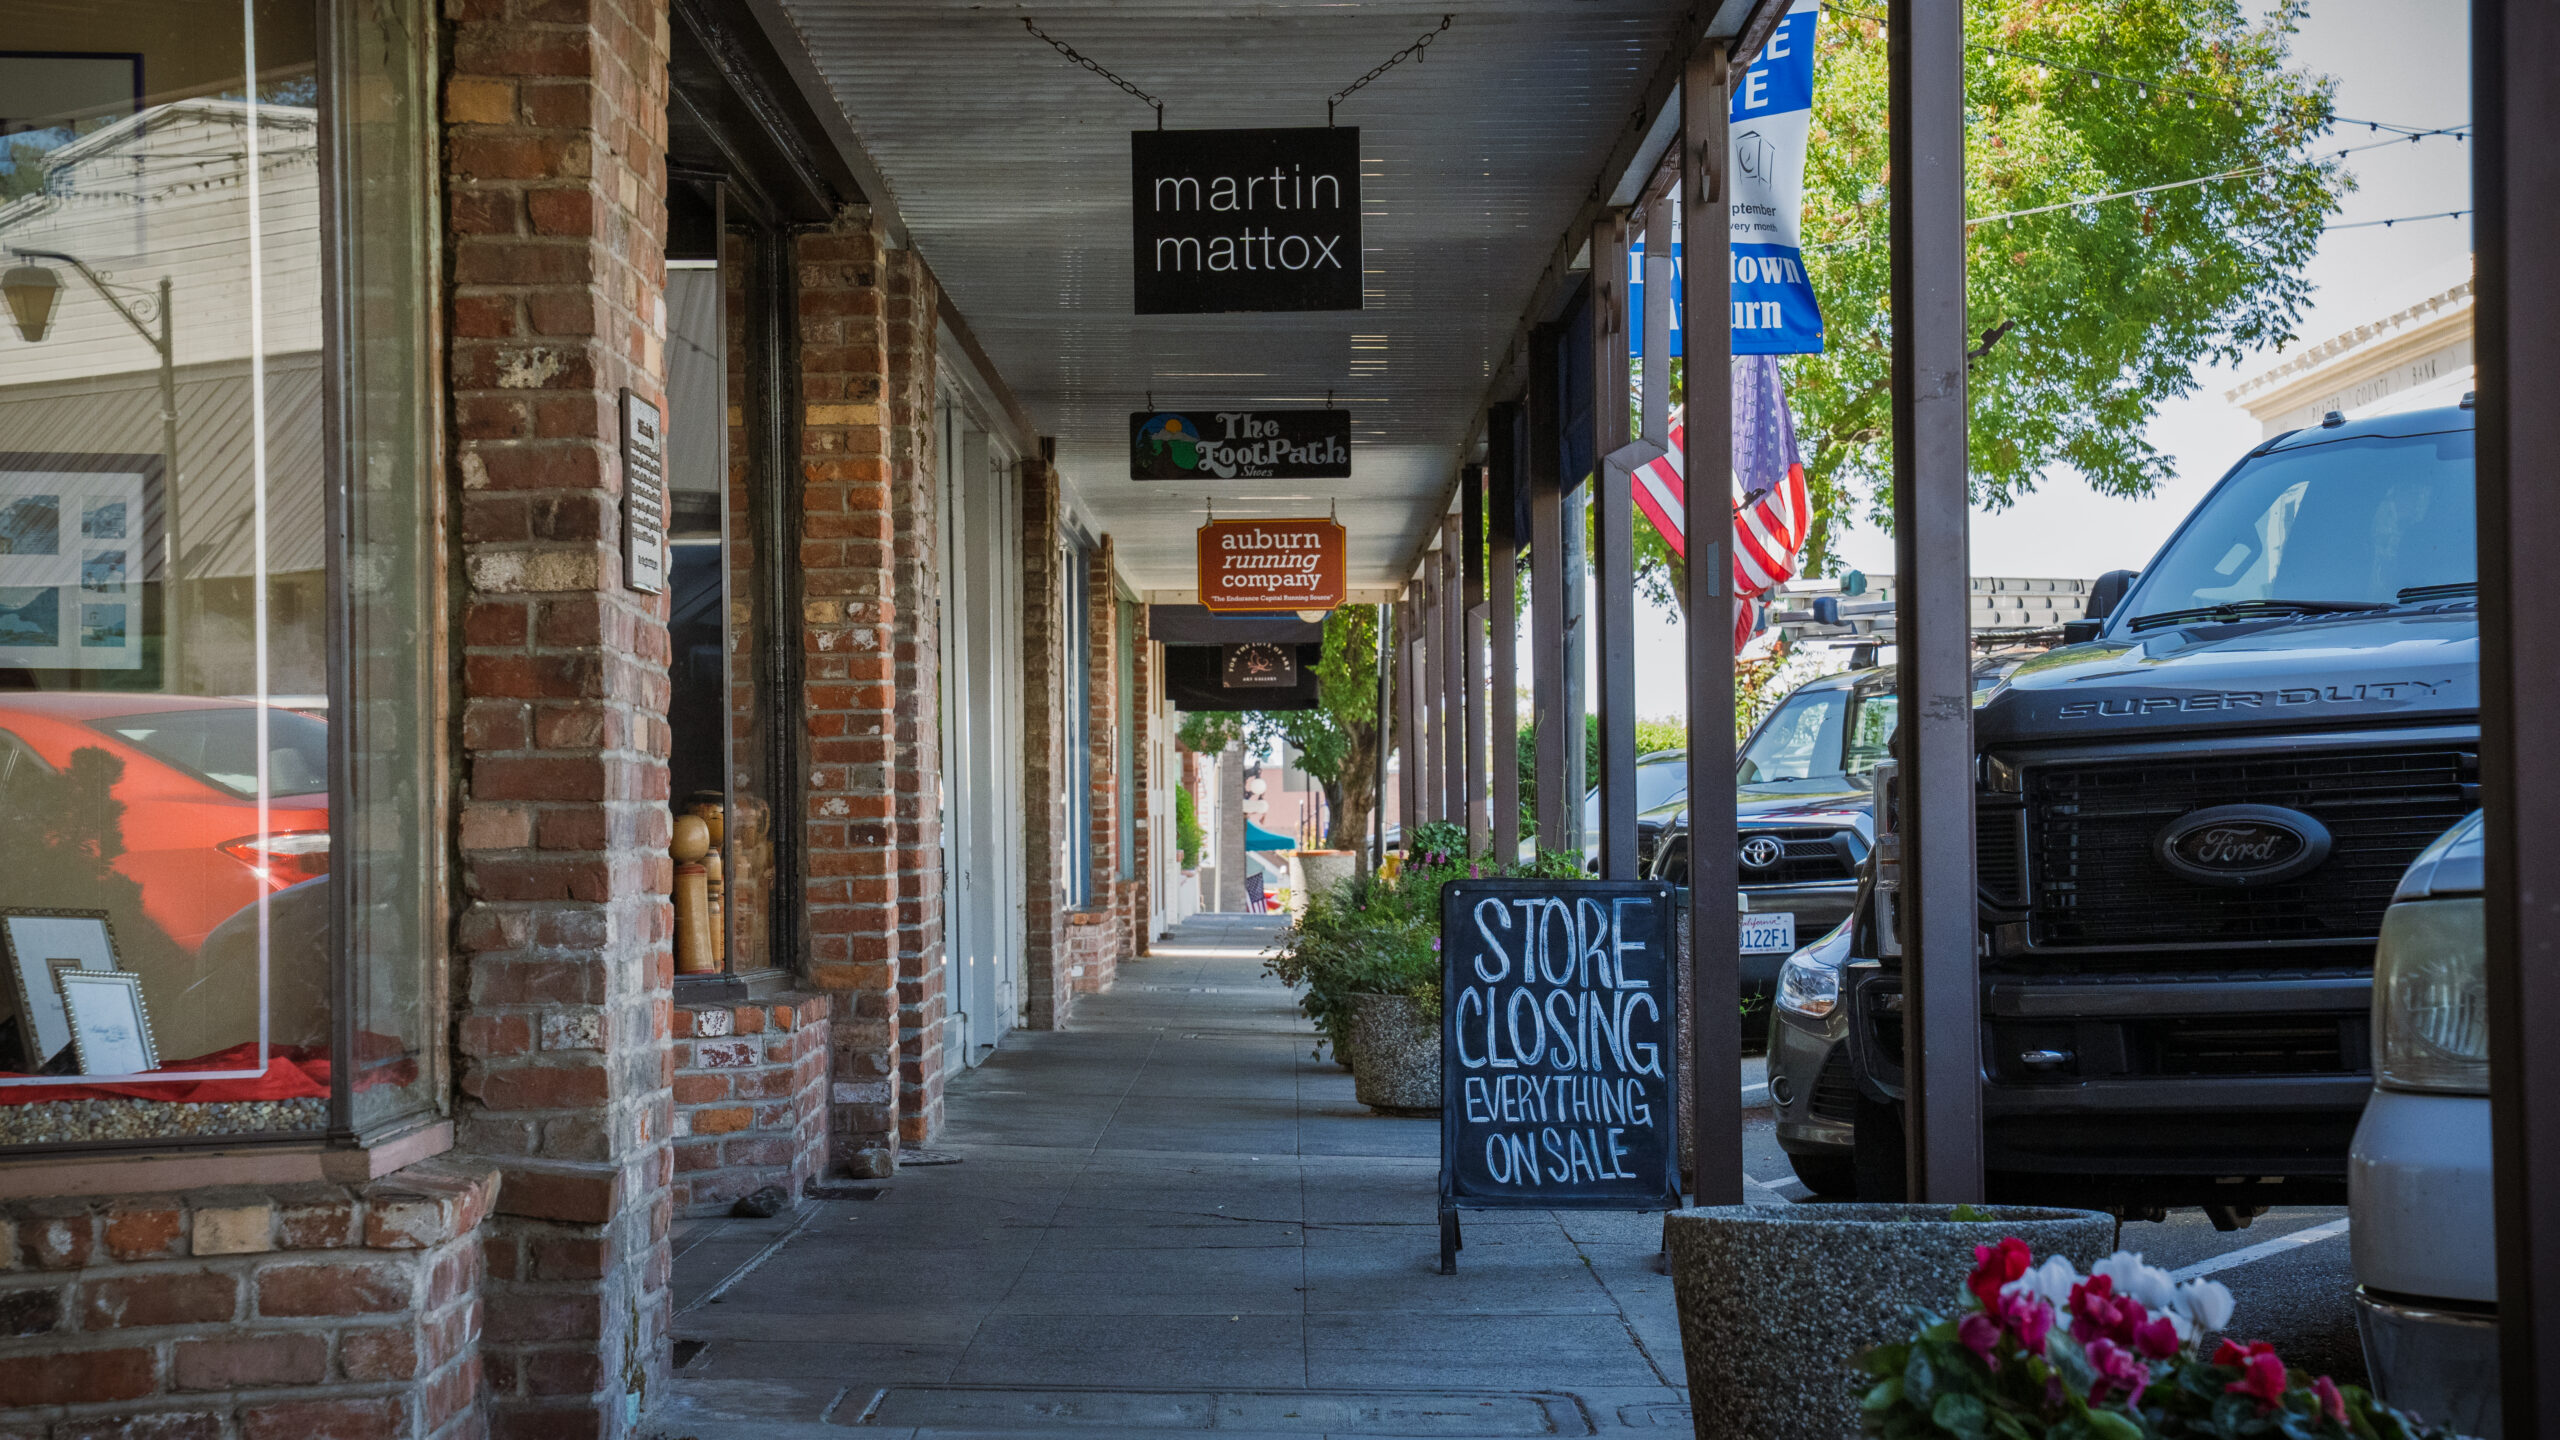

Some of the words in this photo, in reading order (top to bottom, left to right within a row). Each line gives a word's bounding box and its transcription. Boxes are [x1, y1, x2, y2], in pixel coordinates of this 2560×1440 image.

[1155, 163, 1340, 212] martin
[1730, 223, 1750, 232] very
[1754, 223, 1778, 232] month
[1156, 226, 1342, 272] mattox
[2355, 379, 2389, 408] COUNTY
[2412, 359, 2437, 386] BANK
[1215, 412, 1280, 440] The
[1195, 436, 1347, 479] FootPath
[1241, 465, 1274, 477] Shoes
[1221, 528, 1321, 550] auburn
[1222, 549, 1321, 573] running
[1222, 573, 1322, 591] company
[1260, 594, 1282, 602] Capital
[1283, 594, 1308, 602] Running
[1235, 643, 1250, 655] THE
[2059, 690, 2264, 720] SUPER
[2276, 679, 2452, 706] DUTY
[2198, 828, 2282, 862] Ford
[1743, 917, 1777, 929] alifornia
[1474, 896, 1652, 989] STORE
[1456, 986, 1665, 1079] CLOSING
[1465, 1075, 1654, 1127] EVERYTHING
[1486, 1131, 1541, 1186] ON
[1543, 1126, 1637, 1184] SALE
